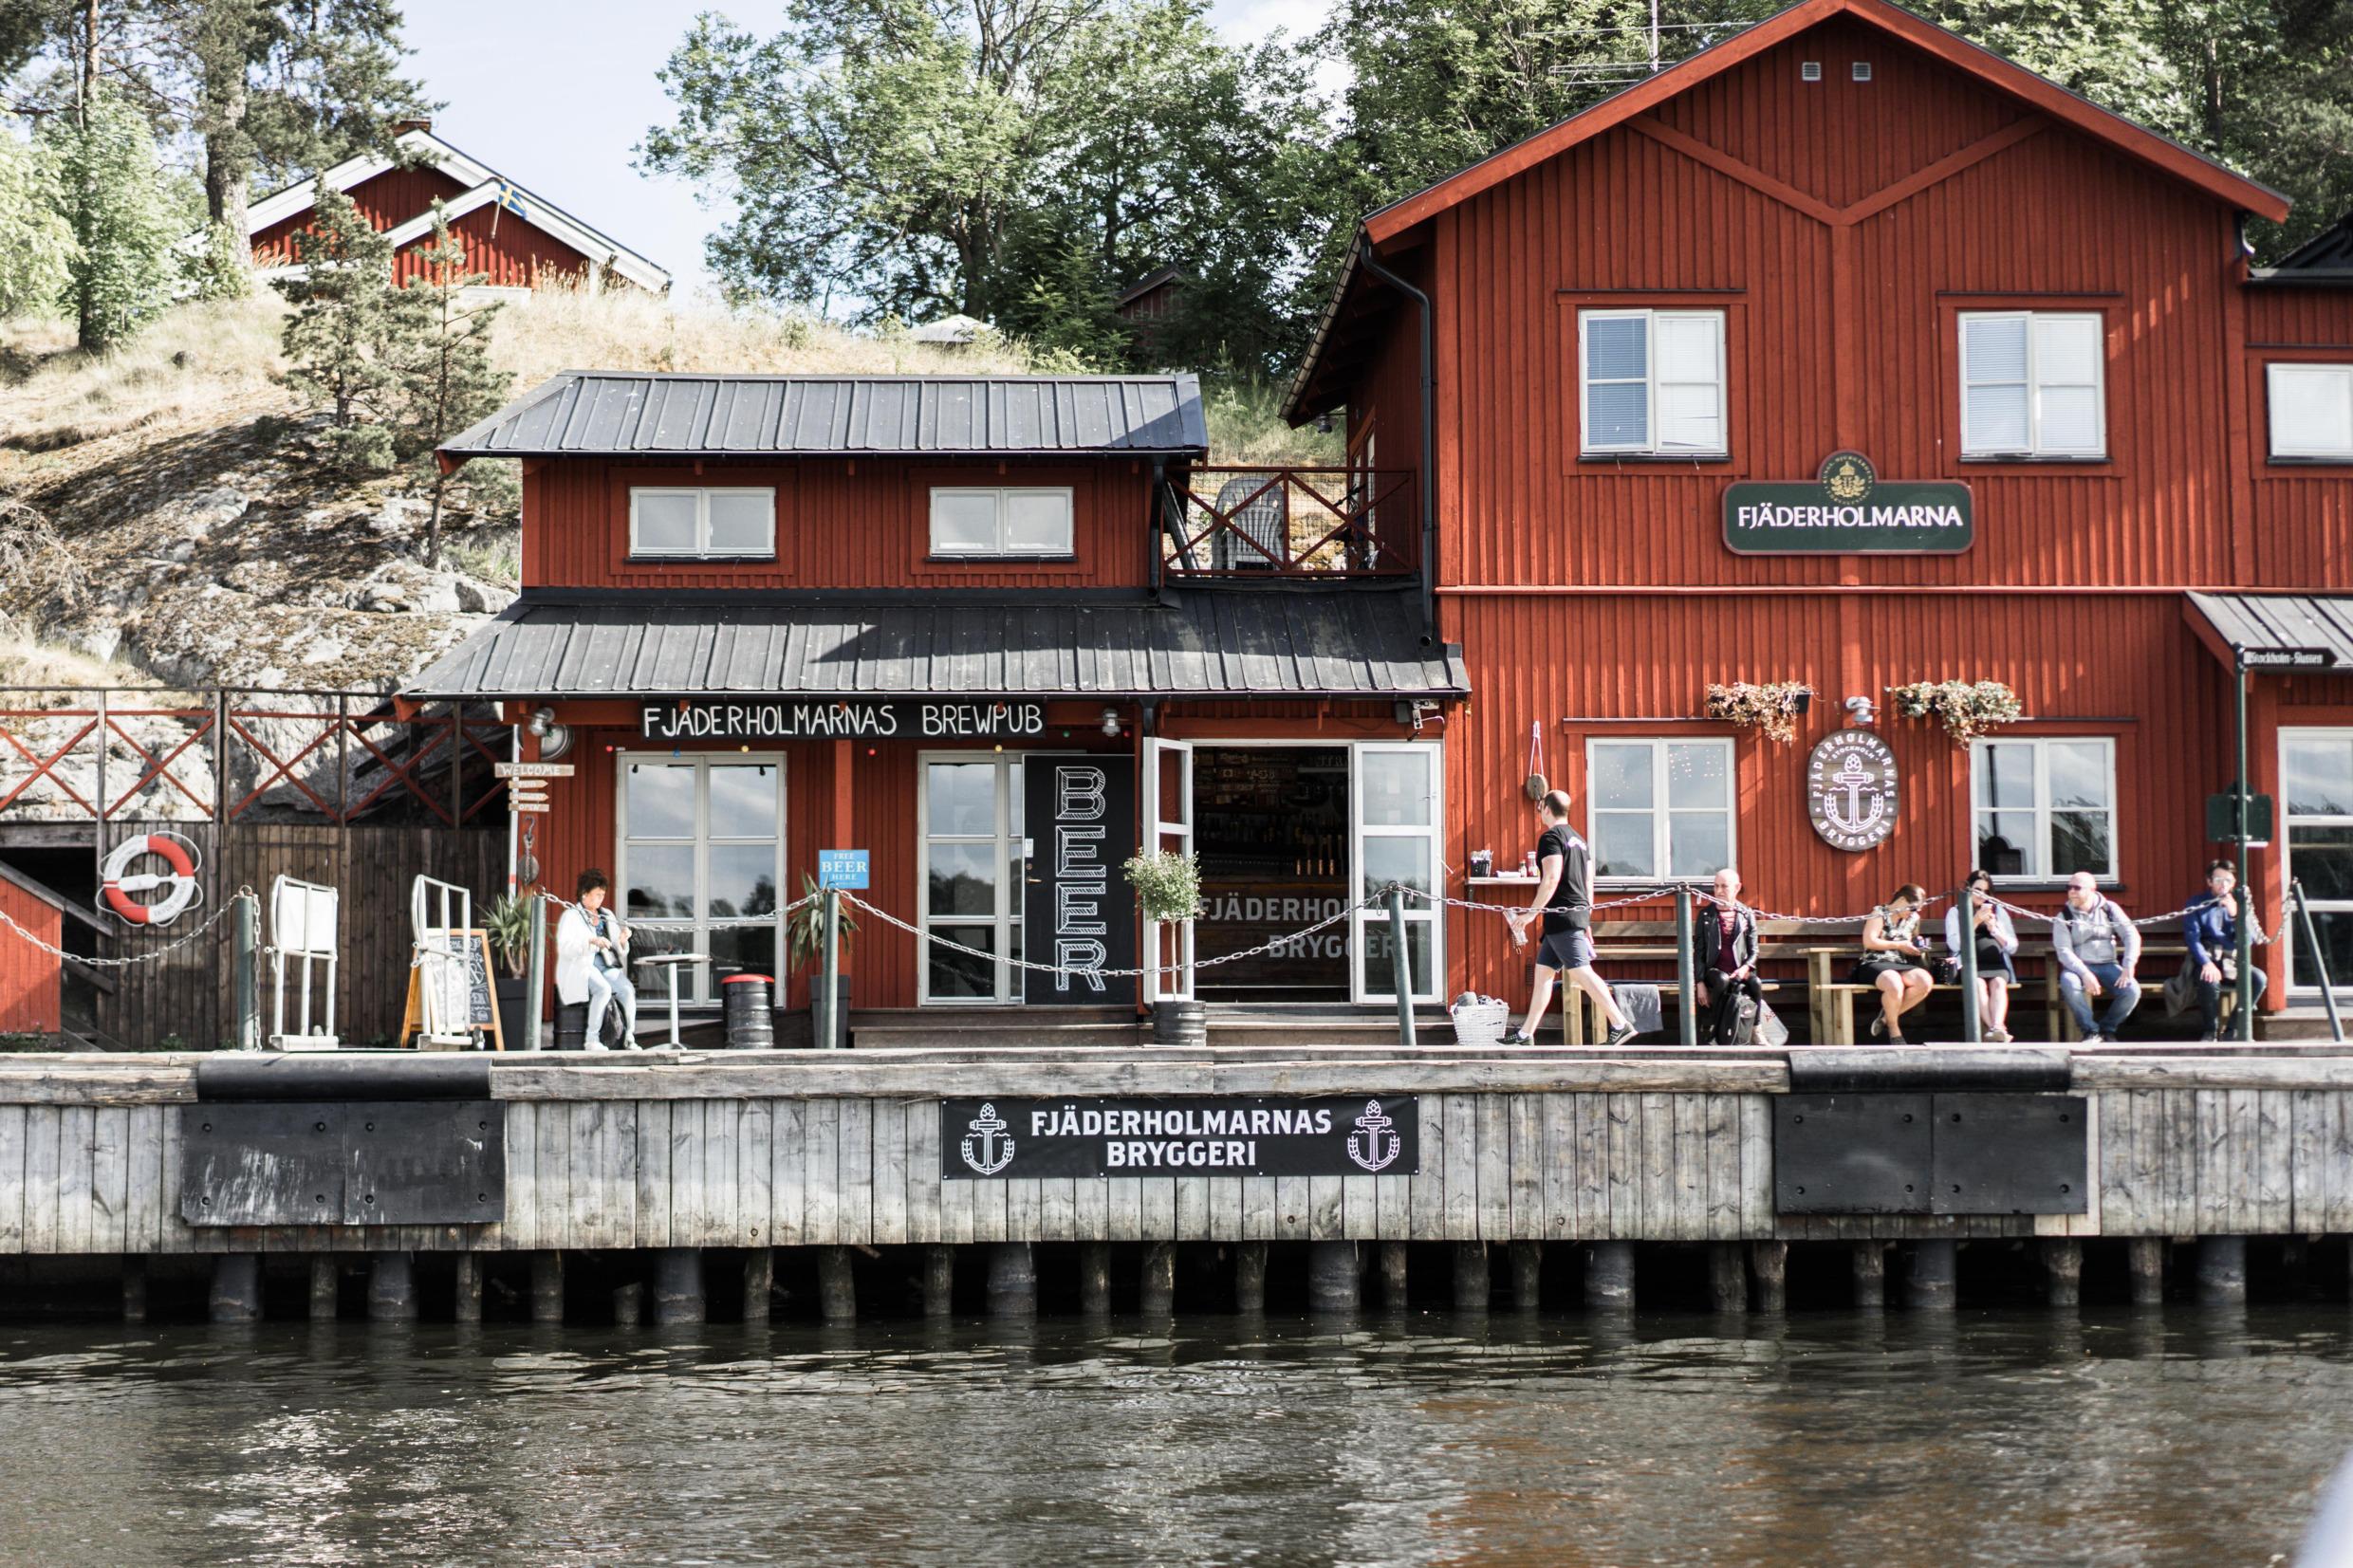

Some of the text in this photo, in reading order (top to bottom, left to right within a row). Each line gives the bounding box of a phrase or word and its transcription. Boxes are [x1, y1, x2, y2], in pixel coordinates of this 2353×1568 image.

[1737, 502, 1963, 529] FJÄDERHOLMARNA
[921, 704, 1043, 734] BREWPUB
[1811, 733, 1896, 797] FJÄDERHOLMARNAS
[1831, 746, 1875, 760] STOCKHOLM
[500, 764, 562, 776] WELCOME
[1818, 820, 1891, 846] BRYGGERI
[822, 861, 867, 873] BEER
[1055, 766, 1106, 991] BEER
[1269, 935, 1394, 958] BRYGER
[1031, 1105, 1332, 1137] FJÄDERHOLMARNAS
[1106, 1140, 1256, 1168] BRYGGERI
